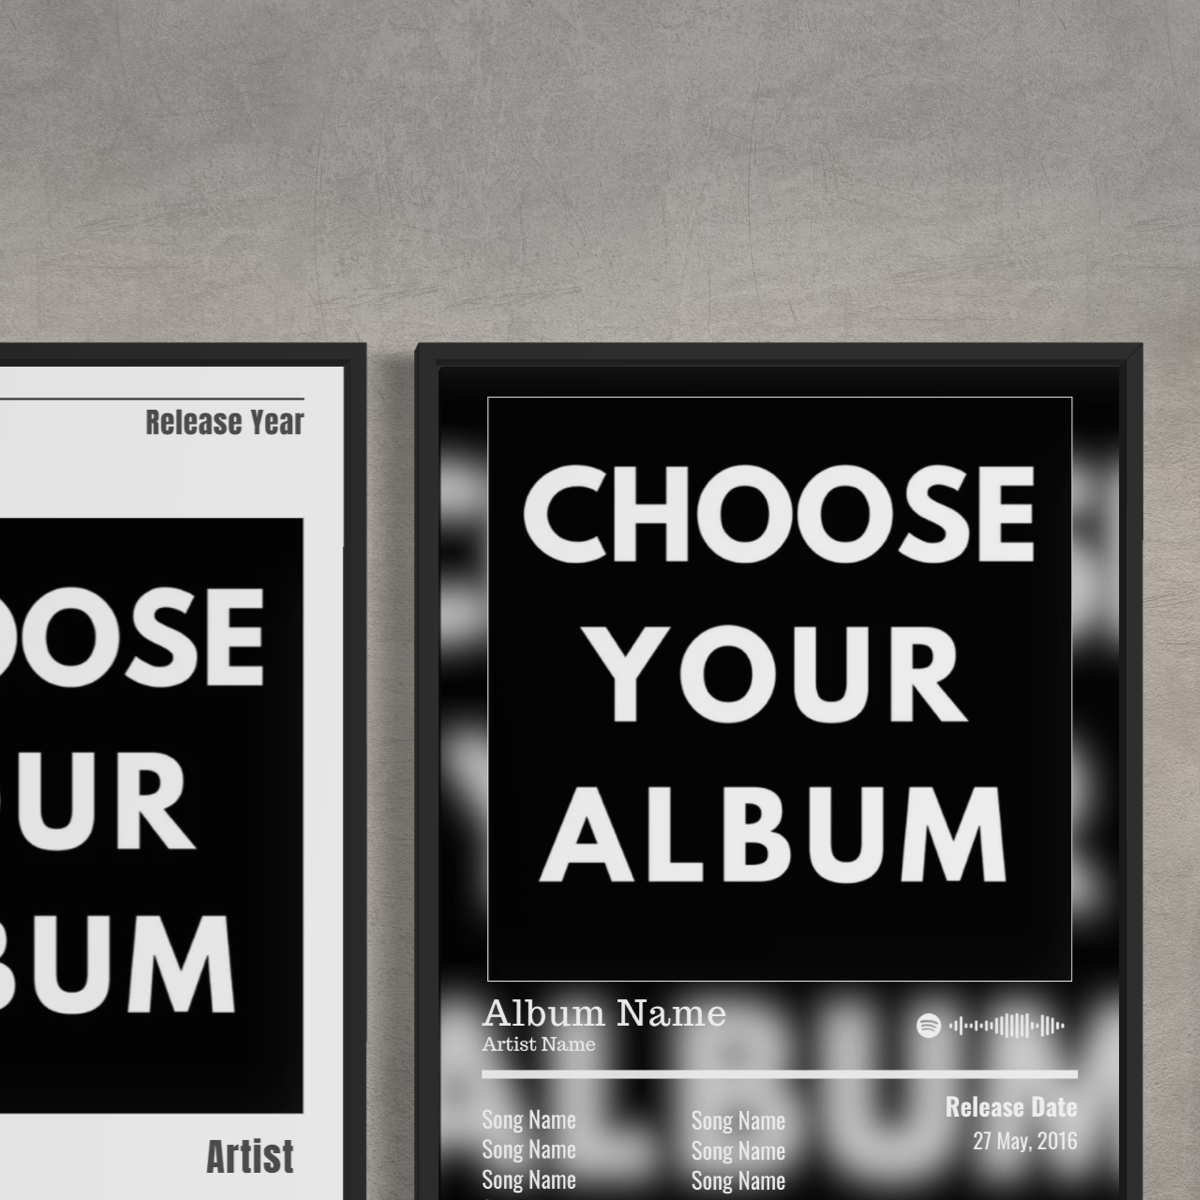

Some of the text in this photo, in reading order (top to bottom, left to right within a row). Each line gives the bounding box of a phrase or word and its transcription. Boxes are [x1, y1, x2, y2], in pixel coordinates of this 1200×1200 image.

[146, 409, 305, 435] Release Year
[523, 464, 1034, 564] CHOOSE
[580, 624, 969, 724] YOUR
[538, 786, 1007, 884] ALBUM
[481, 999, 726, 1027] Album Name
[481, 1036, 596, 1052] Artist Name
[946, 1095, 1078, 1118] Release Date
[482, 1108, 576, 1134] Song Name
[692, 1110, 786, 1134] Song Name
[482, 1138, 576, 1163] Song Name
[692, 1140, 786, 1165] Song Name
[973, 1130, 1078, 1153] 27 May, 2016
[206, 1137, 294, 1174] Artist
[482, 1169, 576, 1193] Song Name
[692, 1170, 785, 1194] Song Name
